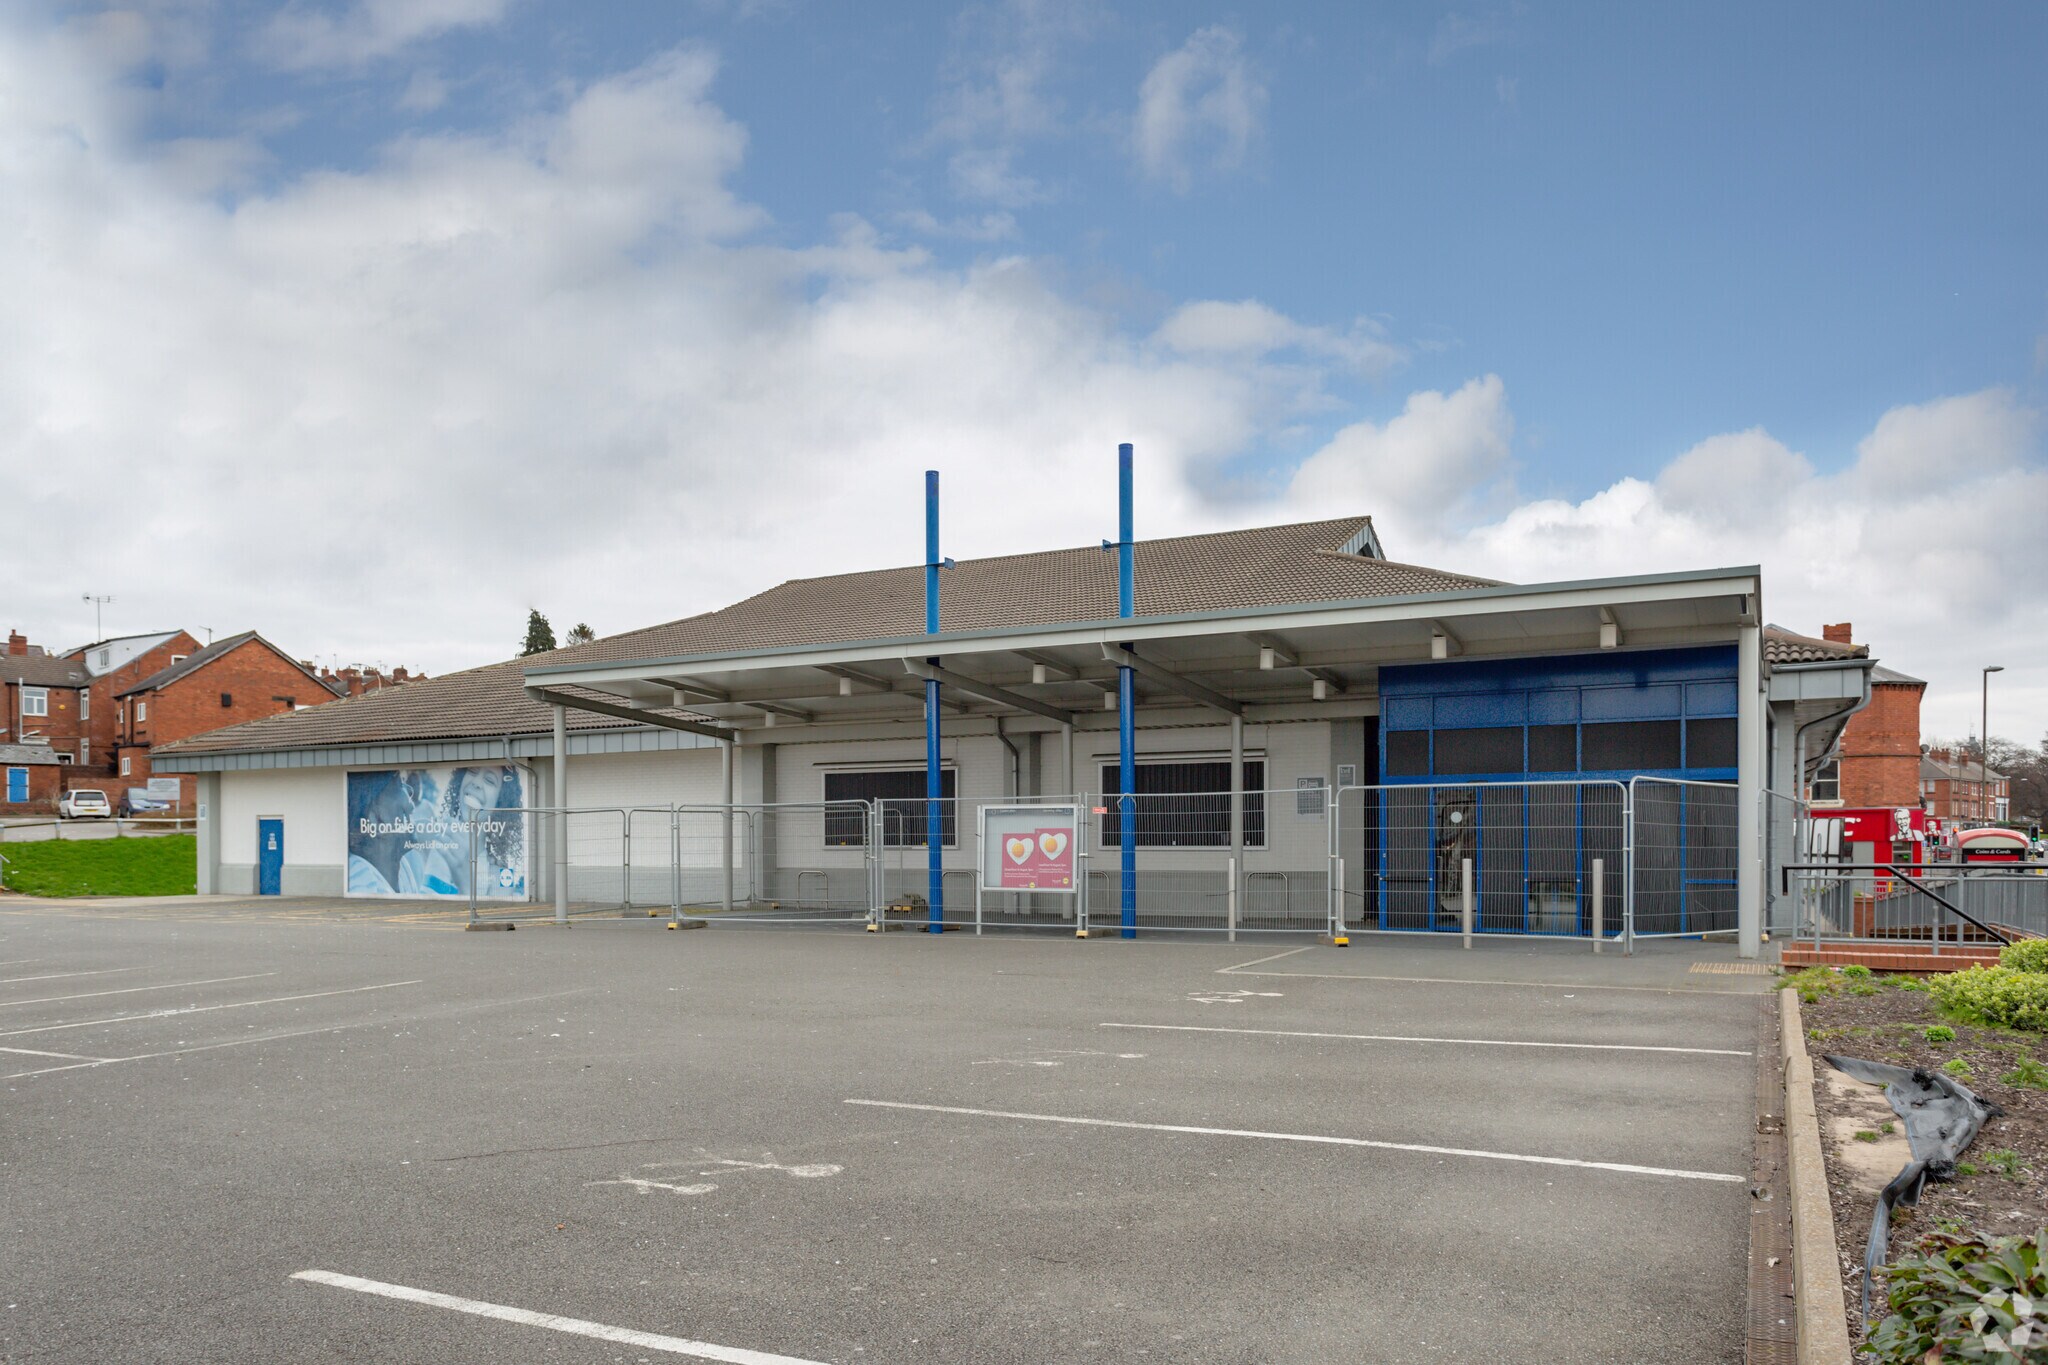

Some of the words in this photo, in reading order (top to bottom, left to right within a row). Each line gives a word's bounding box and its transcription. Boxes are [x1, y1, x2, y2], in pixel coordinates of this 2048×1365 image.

[360, 818, 377, 838] Big
[378, 822, 392, 834] on
[393, 816, 415, 834] five
[416, 822, 424, 834] a
[426, 818, 448, 837] day
[450, 815, 506, 837] everyday
[404, 840, 425, 851] Always
